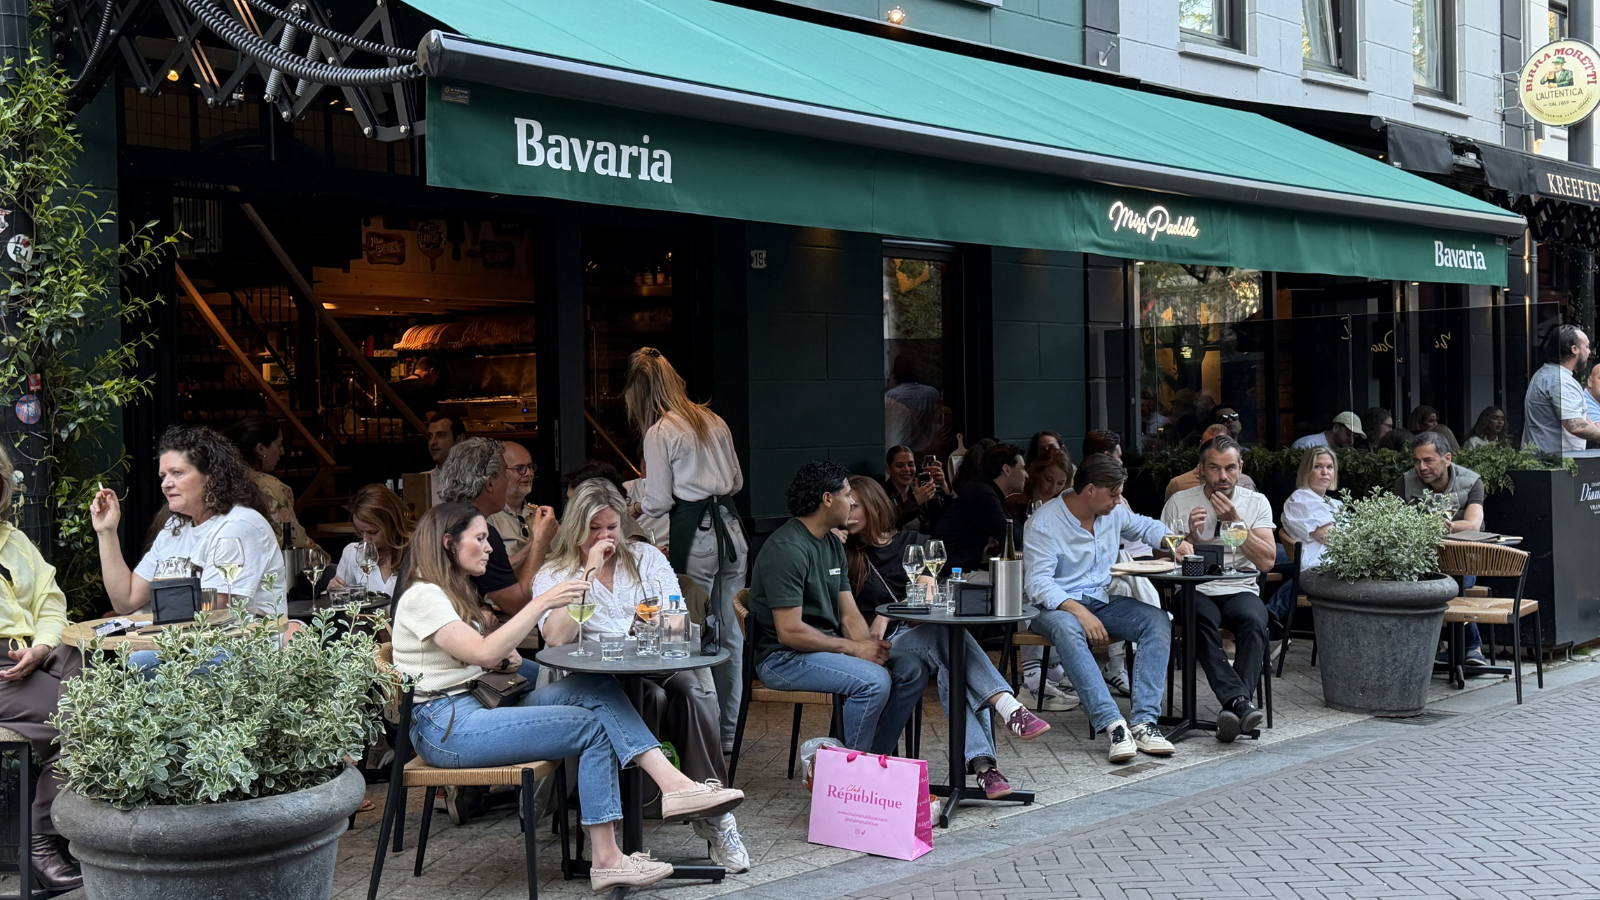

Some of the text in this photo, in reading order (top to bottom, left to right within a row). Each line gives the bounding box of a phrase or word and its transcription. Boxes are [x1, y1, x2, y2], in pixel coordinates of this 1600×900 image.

[1526, 47, 1597, 93] BIRRA MORETTI
[1535, 87, 1584, 101] L'AUTENTICA
[514, 117, 673, 184] Bavaria
[1108, 200, 1200, 242] Miss Paddle
[1434, 240, 1487, 270] Bavaria
[827, 784, 902, 810] République
[846, 784, 862, 793] Club
